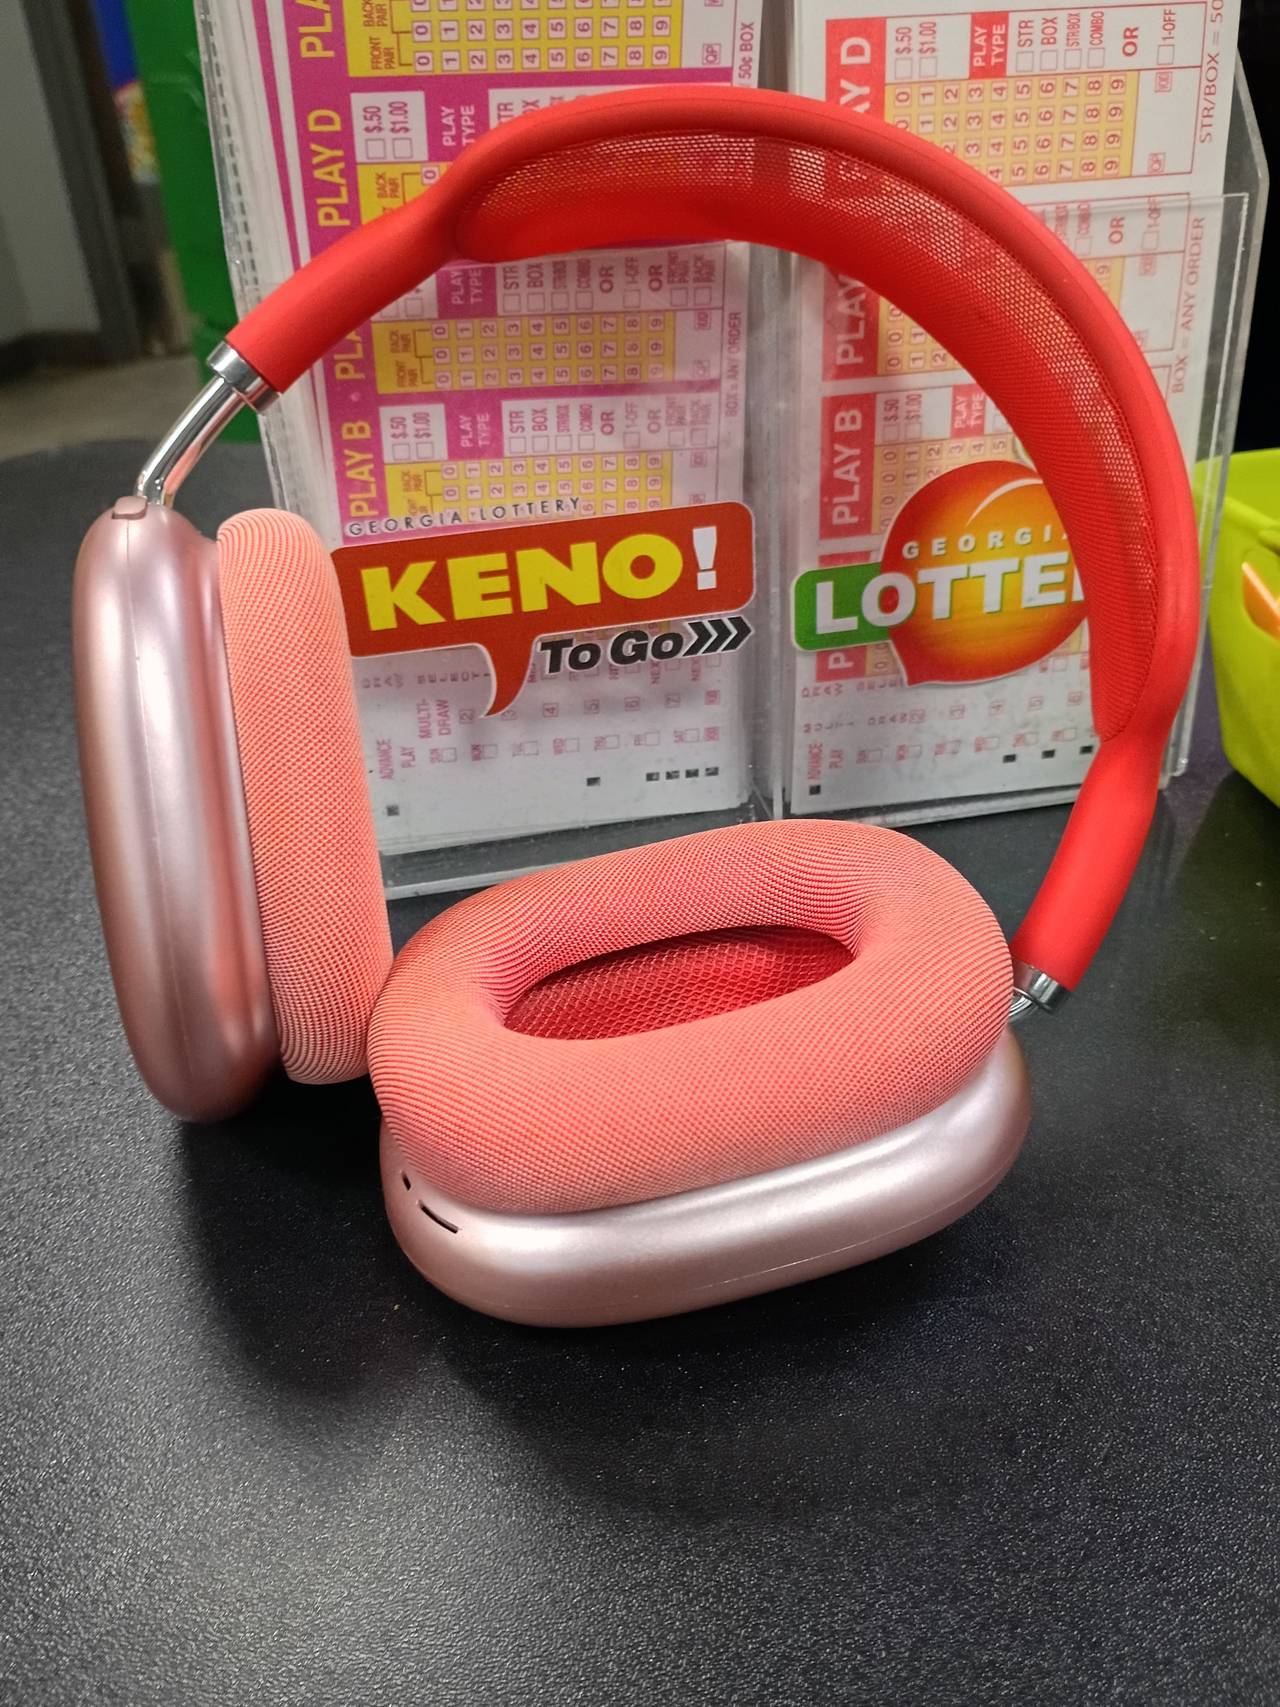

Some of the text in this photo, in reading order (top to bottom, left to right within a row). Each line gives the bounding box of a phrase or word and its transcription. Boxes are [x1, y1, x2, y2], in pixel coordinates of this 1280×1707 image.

[297, 0, 335, 58] PLA
[377, 4, 387, 27] PAIR
[1041, 16, 1058, 46] BOX
[1066, 12, 1081, 47] STR/BOX
[1090, 10, 1104, 46] COMBO
[1162, 9, 1176, 41] 1-OFF
[414, 25, 430, 66] 0 0
[469, 24, 484, 65] 2 2
[496, 24, 511, 64] 3 3
[524, 24, 537, 64] 4 4
[551, 22, 564, 62] 5 5
[577, 22, 590, 62] 6 6
[603, 21, 616, 62] 7 7
[629, 20, 642, 61] 8 8
[654, 20, 668, 60] 9 9
[740, 22, 754, 52] BOX
[840, 37, 870, 65] D
[896, 26, 912, 54] $.50
[919, 21, 936, 54] $1.00
[973, 26, 988, 66] PLAY
[992, 24, 1006, 65] TYPE
[1018, 20, 1034, 48] STR
[1122, 26, 1139, 57] OR
[370, 36, 382, 70] FRONT
[384, 47, 396, 70] PAIR
[498, 101, 514, 124] TR
[895, 91, 911, 103] 0
[943, 89, 958, 127] 2 2
[1200, 52, 1220, 144] STR/BOX
[364, 105, 383, 133] $.50
[390, 100, 410, 133] $1.00
[442, 106, 456, 146] PLAY
[460, 105, 475, 145] TYPE
[964, 87, 984, 154] 3 3 3
[989, 86, 1006, 178] 4 4 4 4
[1011, 84, 1031, 176] 5 5 5 5
[1034, 82, 1055, 176] 6 6 6 6
[1058, 81, 1078, 174] 7 7 7 7
[1081, 80, 1102, 172] 8 8 8 8
[1104, 79, 1125, 171] 9 9 9 9
[308, 109, 350, 227] PLAY D
[1108, 217, 1126, 244] OR
[452, 270, 464, 305] PLAY
[470, 269, 482, 304] TYPE
[504, 264, 520, 290] STR
[600, 265, 614, 293] OR
[648, 264, 662, 292] OR
[836, 275, 866, 366] PLAY
[1172, 217, 1204, 393] BOX ANY ORDER
[727, 312, 741, 354] ORDER
[887, 332, 902, 368] 0 0
[934, 352, 947, 362] 2
[510, 410, 525, 434] STR
[600, 410, 614, 436] OR
[647, 410, 661, 434] OR
[954, 397, 966, 428] PLAY
[972, 393, 985, 428] TYPE
[459, 414, 473, 448] PLAY
[476, 413, 490, 447] TYPE
[341, 420, 379, 517] PLAY B
[832, 410, 862, 525] PLAY B
[350, 497, 580, 536] GEORGIA LOTTERY
[903, 525, 1067, 560] GEORGI
[361, 526, 718, 631] KENO!
[540, 638, 601, 674] To
[610, 627, 684, 665] Go
[436, 700, 451, 736] DRAW
[377, 739, 394, 780] ADVANCE
[402, 746, 416, 768] PLAY
[808, 743, 822, 781] ADVANCE
[829, 750, 844, 768] PLAY
